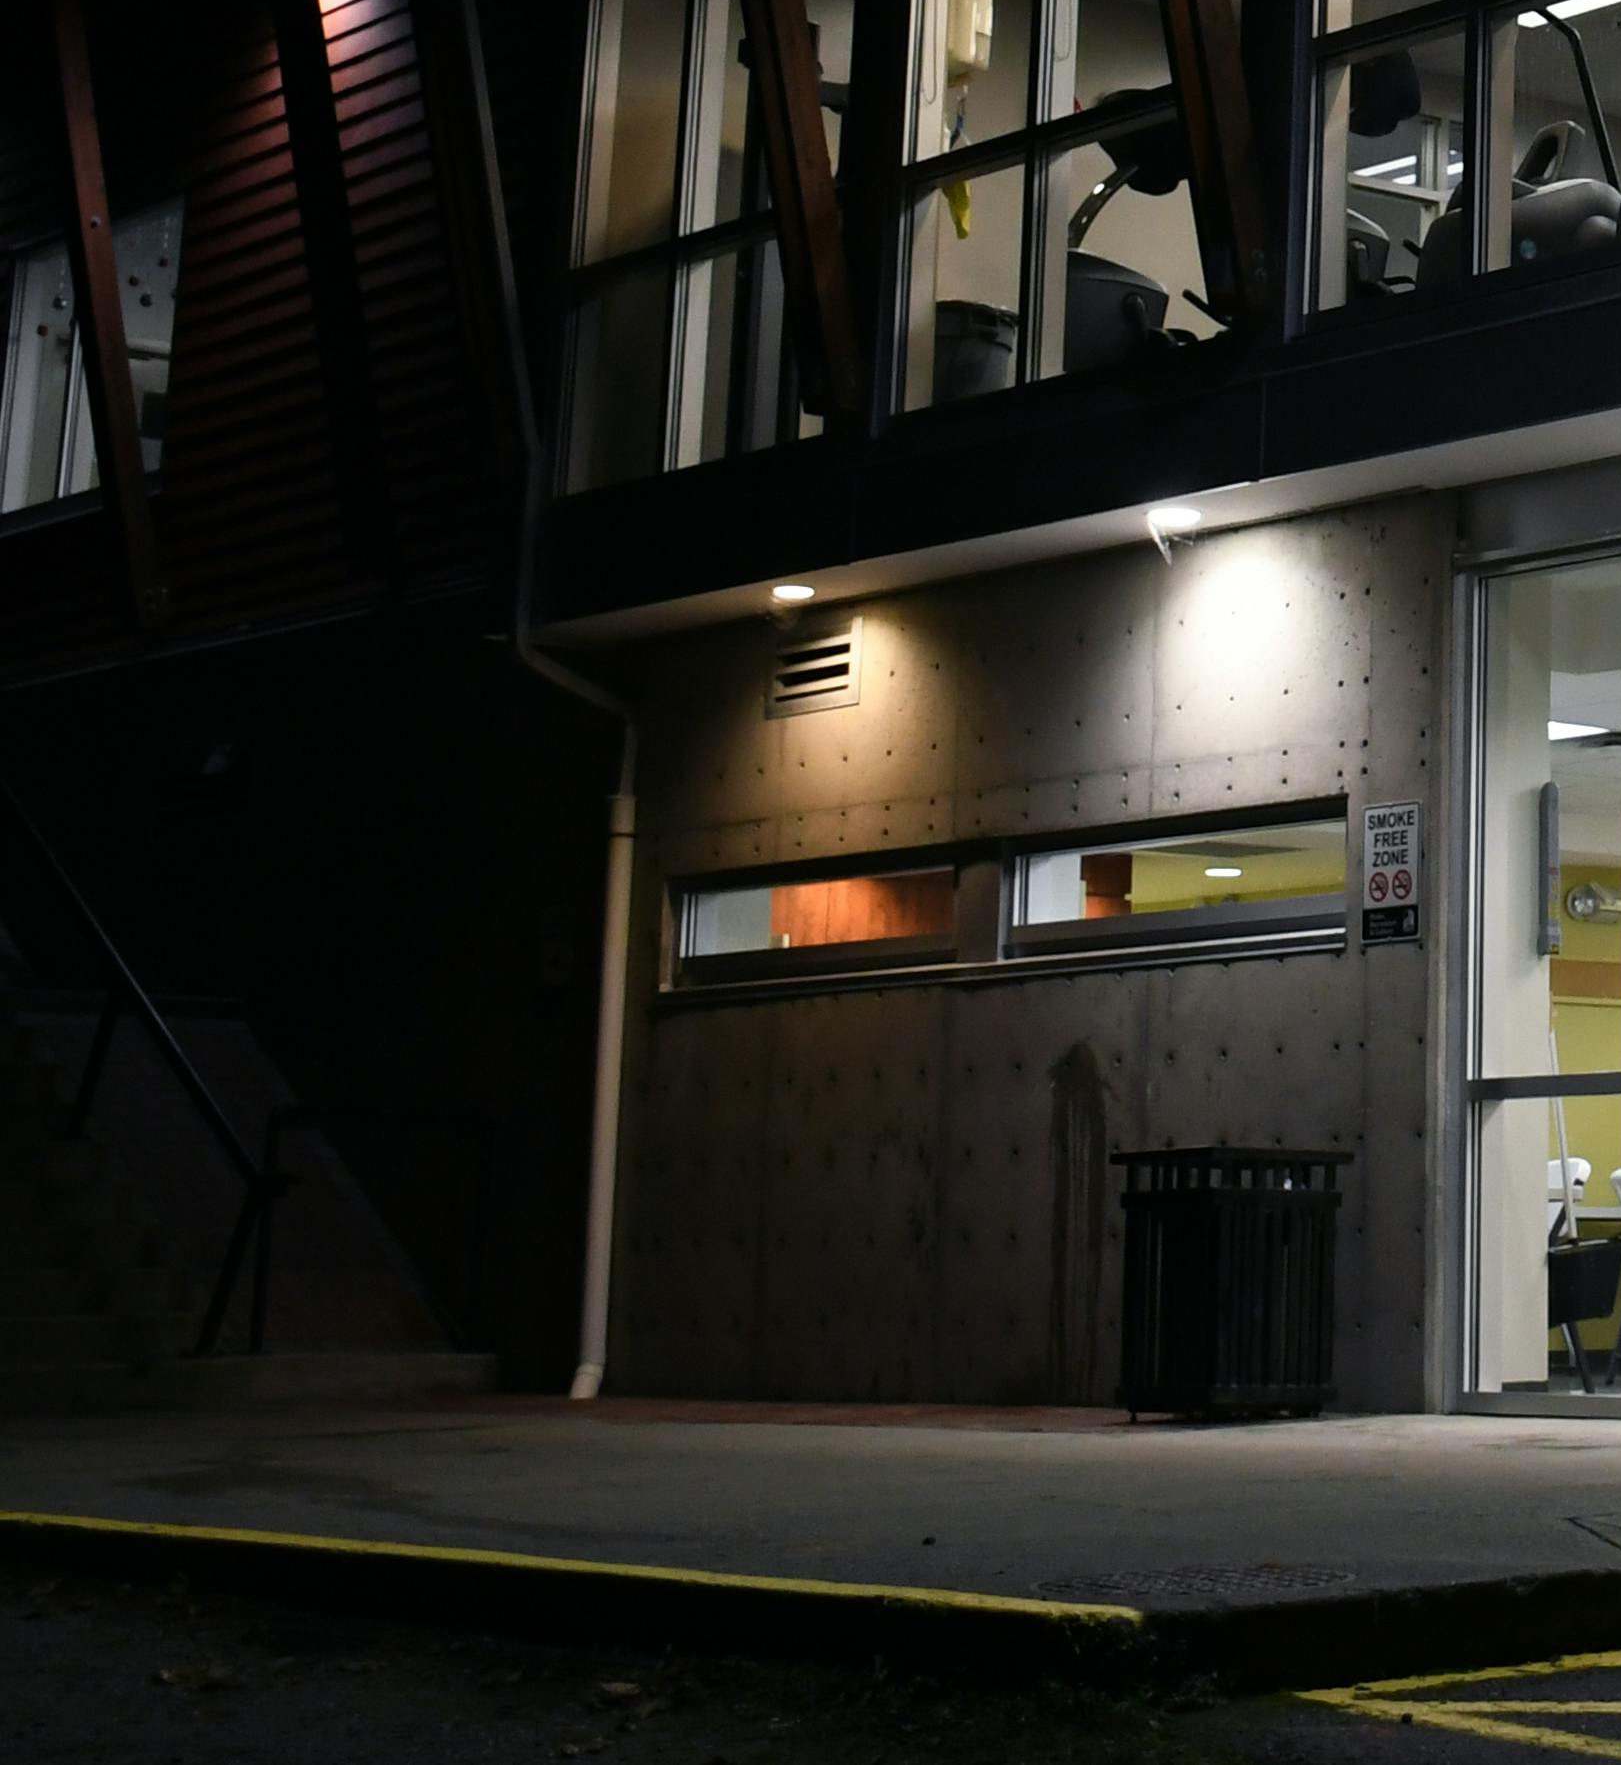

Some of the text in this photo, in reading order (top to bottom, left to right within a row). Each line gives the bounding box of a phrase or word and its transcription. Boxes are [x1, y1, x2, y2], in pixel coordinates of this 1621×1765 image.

[1367, 810, 1415, 831] SMOKE
[1373, 829, 1409, 849] FREE
[1372, 849, 1409, 868] ZONE
